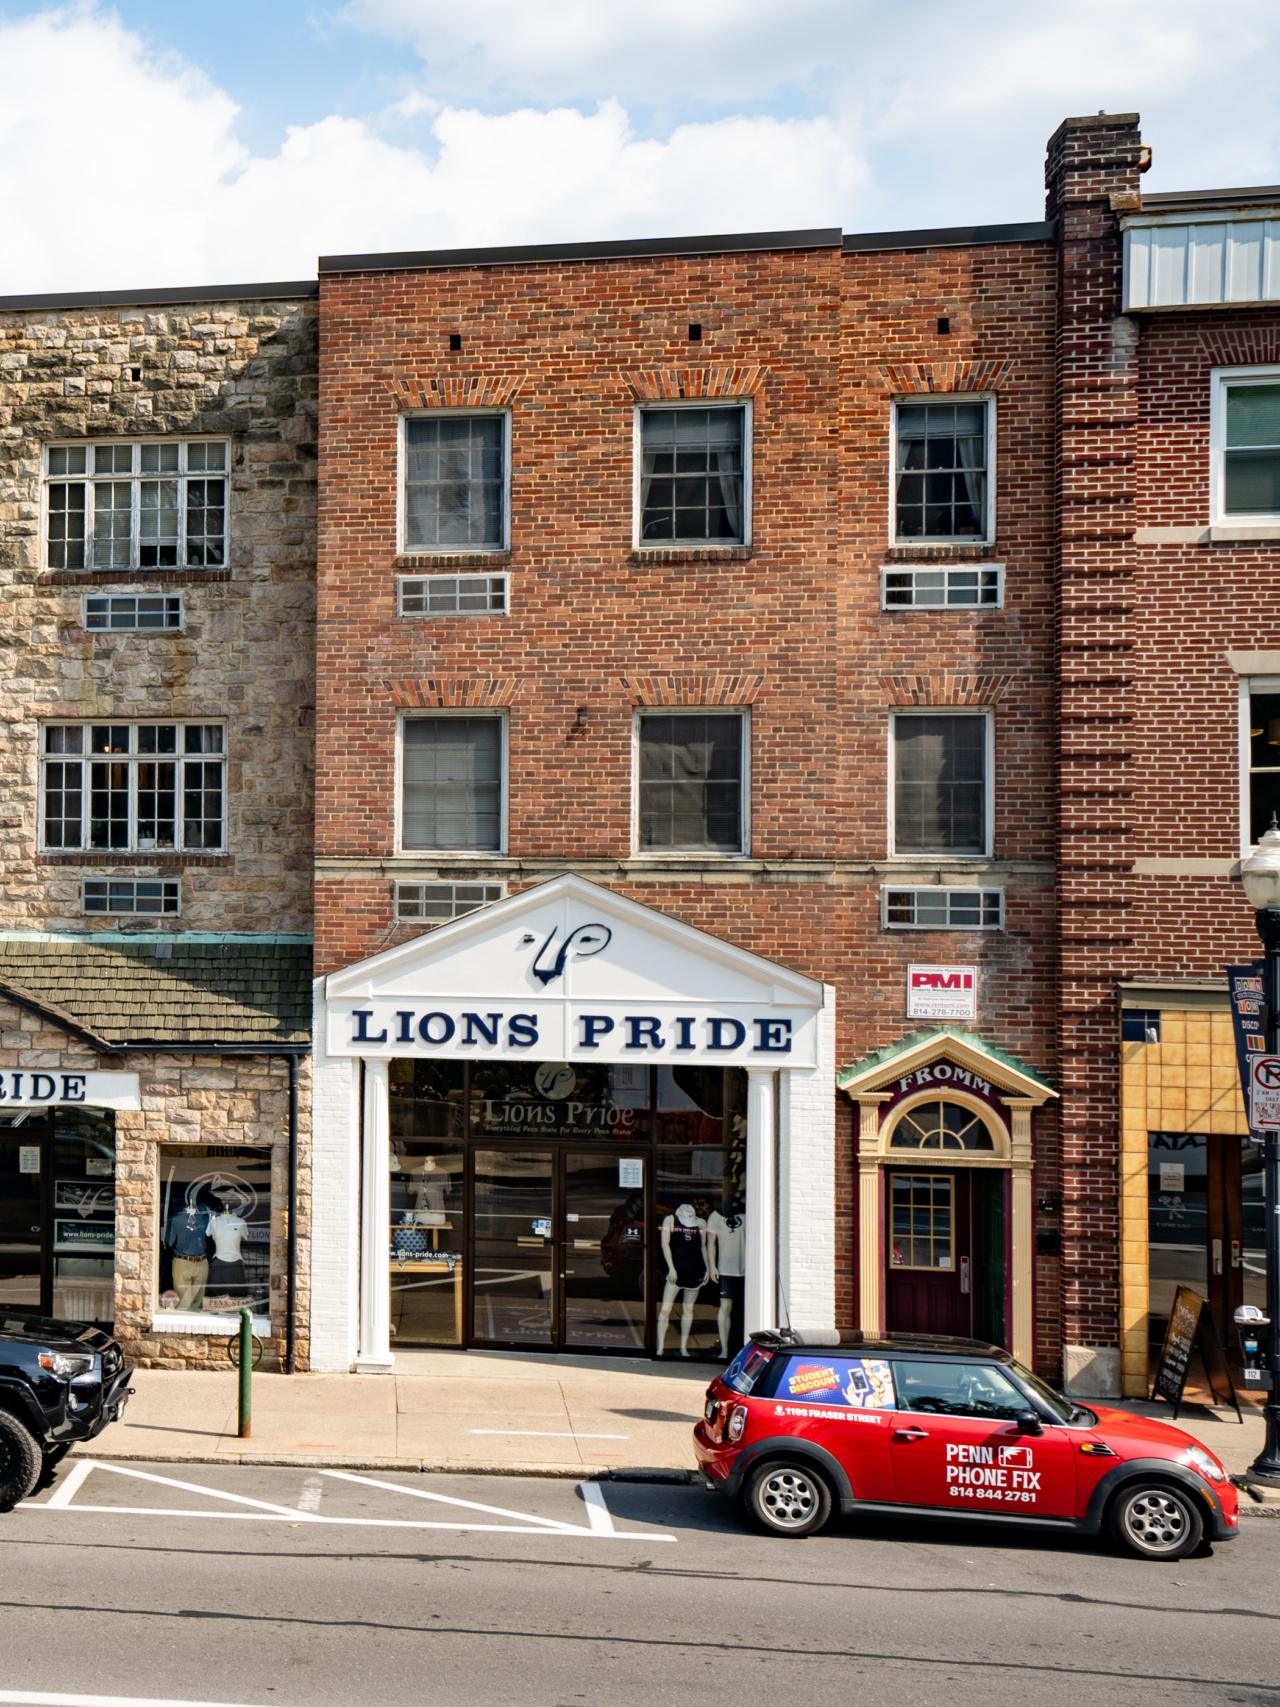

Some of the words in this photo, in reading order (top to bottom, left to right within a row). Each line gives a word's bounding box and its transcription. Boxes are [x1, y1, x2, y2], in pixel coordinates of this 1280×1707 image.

[912, 973, 972, 989] PMI
[351, 1010, 539, 1048] LIONS
[579, 1015, 792, 1052] PRIDE
[900, 1065, 993, 1097] FROMM
[485, 1100, 556, 1124] Lions
[566, 1099, 635, 1126] Pride
[788, 1367, 835, 1386] STUDENT
[788, 1374, 841, 1394] DISCOUNT
[809, 1409, 846, 1421] FRASER
[846, 1414, 882, 1424] STREET
[946, 1443, 994, 1465] PENN
[946, 1465, 1008, 1487] PHONE
[1012, 1470, 1042, 1490] FIX
[949, 1486, 974, 1498] 814
[976, 1488, 1003, 1500] 844
[1004, 1491, 1037, 1503] 2781
